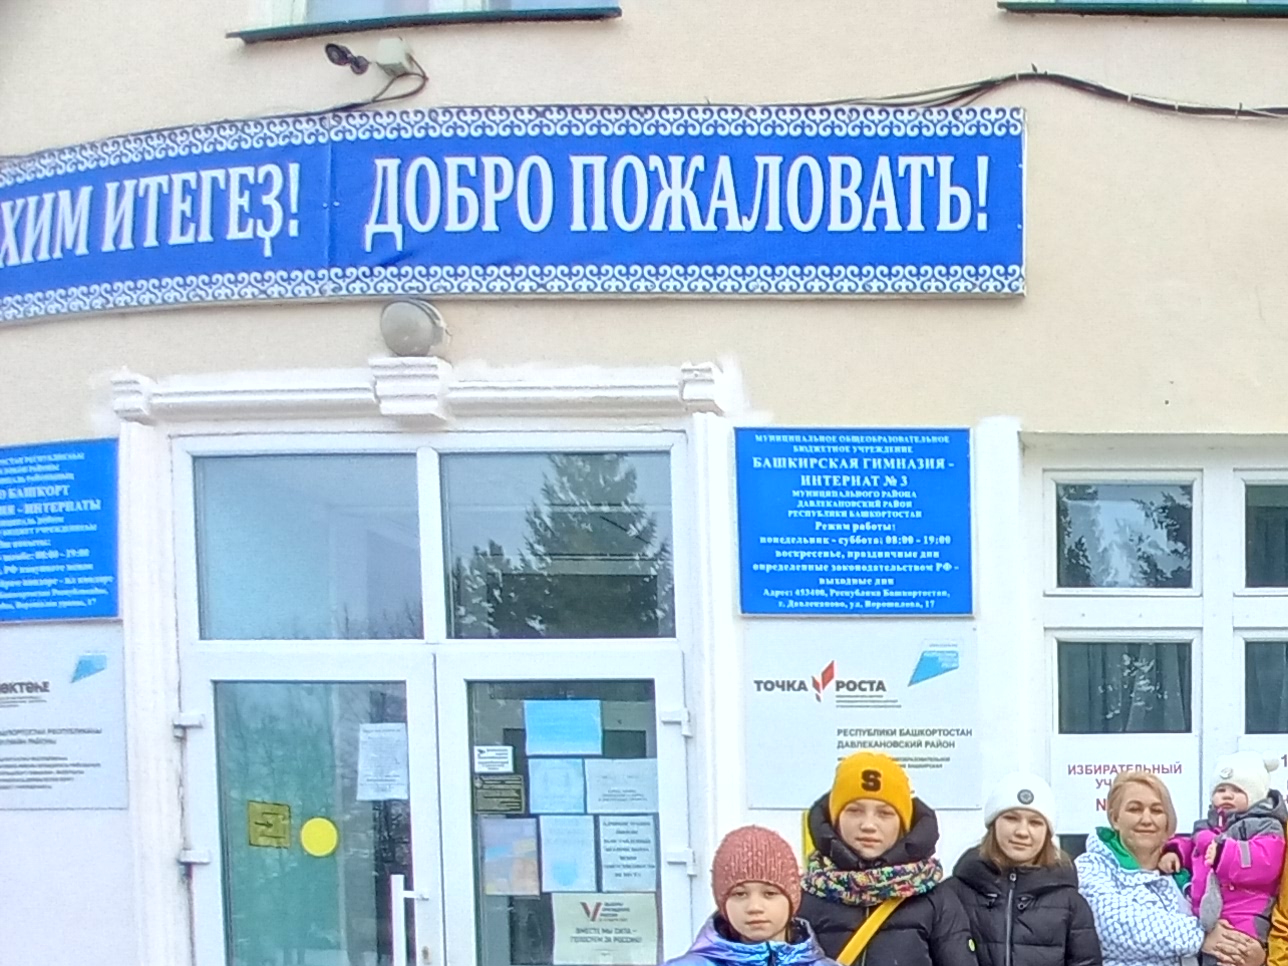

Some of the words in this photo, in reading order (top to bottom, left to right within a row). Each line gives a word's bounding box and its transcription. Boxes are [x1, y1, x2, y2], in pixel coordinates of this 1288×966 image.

[364, 155, 553, 253] ДОБРО
[569, 155, 990, 233] ПОЖАЛОВАТЬ!
[755, 434, 837, 443] МУНИЦИПАЛЬНОЕ
[839, 434, 950, 444] ОБЩЕОБРАЗОВАТЕЛЬНОЕ
[793, 445, 850, 454] БЮДЖЕТНОЕ
[852, 445, 913, 454] УЧРЕЖДЕНИЕ
[752, 457, 859, 469] БАШКИРСКАЯ
[862, 457, 946, 470] ГИМНАЗИЯ
[800, 475, 880, 486] ИНТЕРНАТ
[883, 475, 897, 487] №
[900, 475, 908, 486] 3
[792, 490, 880, 499] МУНИЦИПАЛЬНОГО
[882, 489, 917, 498] РАЙОНА
[797, 499, 881, 508] ДАВЛЕКАНОВСКИЙ
[883, 499, 912, 508] РАЙОН
[788, 510, 847, 518] РЕСПУБЛИКИ
[849, 510, 922, 518] БАШКОРТОСТАН
[815, 522, 850, 531] Режим
[852, 522, 896, 532] работы:
[760, 536, 829, 545] понедельник
[838, 535, 884, 547] суббота:
[886, 535, 914, 545] 08:00
[923, 535, 951, 545] 19:00
[775, 550, 845, 560] воскресенье,
[847, 550, 917, 561] праздничные
[920, 550, 939, 559] дни
[752, 564, 828, 573] определенные
[831, 563, 933, 572] законодательством
[935, 562, 952, 572] РФ
[819, 577, 872, 586] выходные
[874, 577, 895, 586] дни
[829, 589, 881, 598] Республика
[754, 680, 808, 692] ТОЧКА
[835, 680, 887, 692] РОСТА
[837, 728, 897, 737] РЕСПУБЛИКИ
[899, 728, 973, 737] БАШКОРТОСТАН
[837, 739, 922, 749] ДАВЛЕКАНОВСКИЙ
[924, 739, 955, 749] РАЙОН
[861, 769, 881, 792] S
[1096, 778, 1112, 789] УЧ
